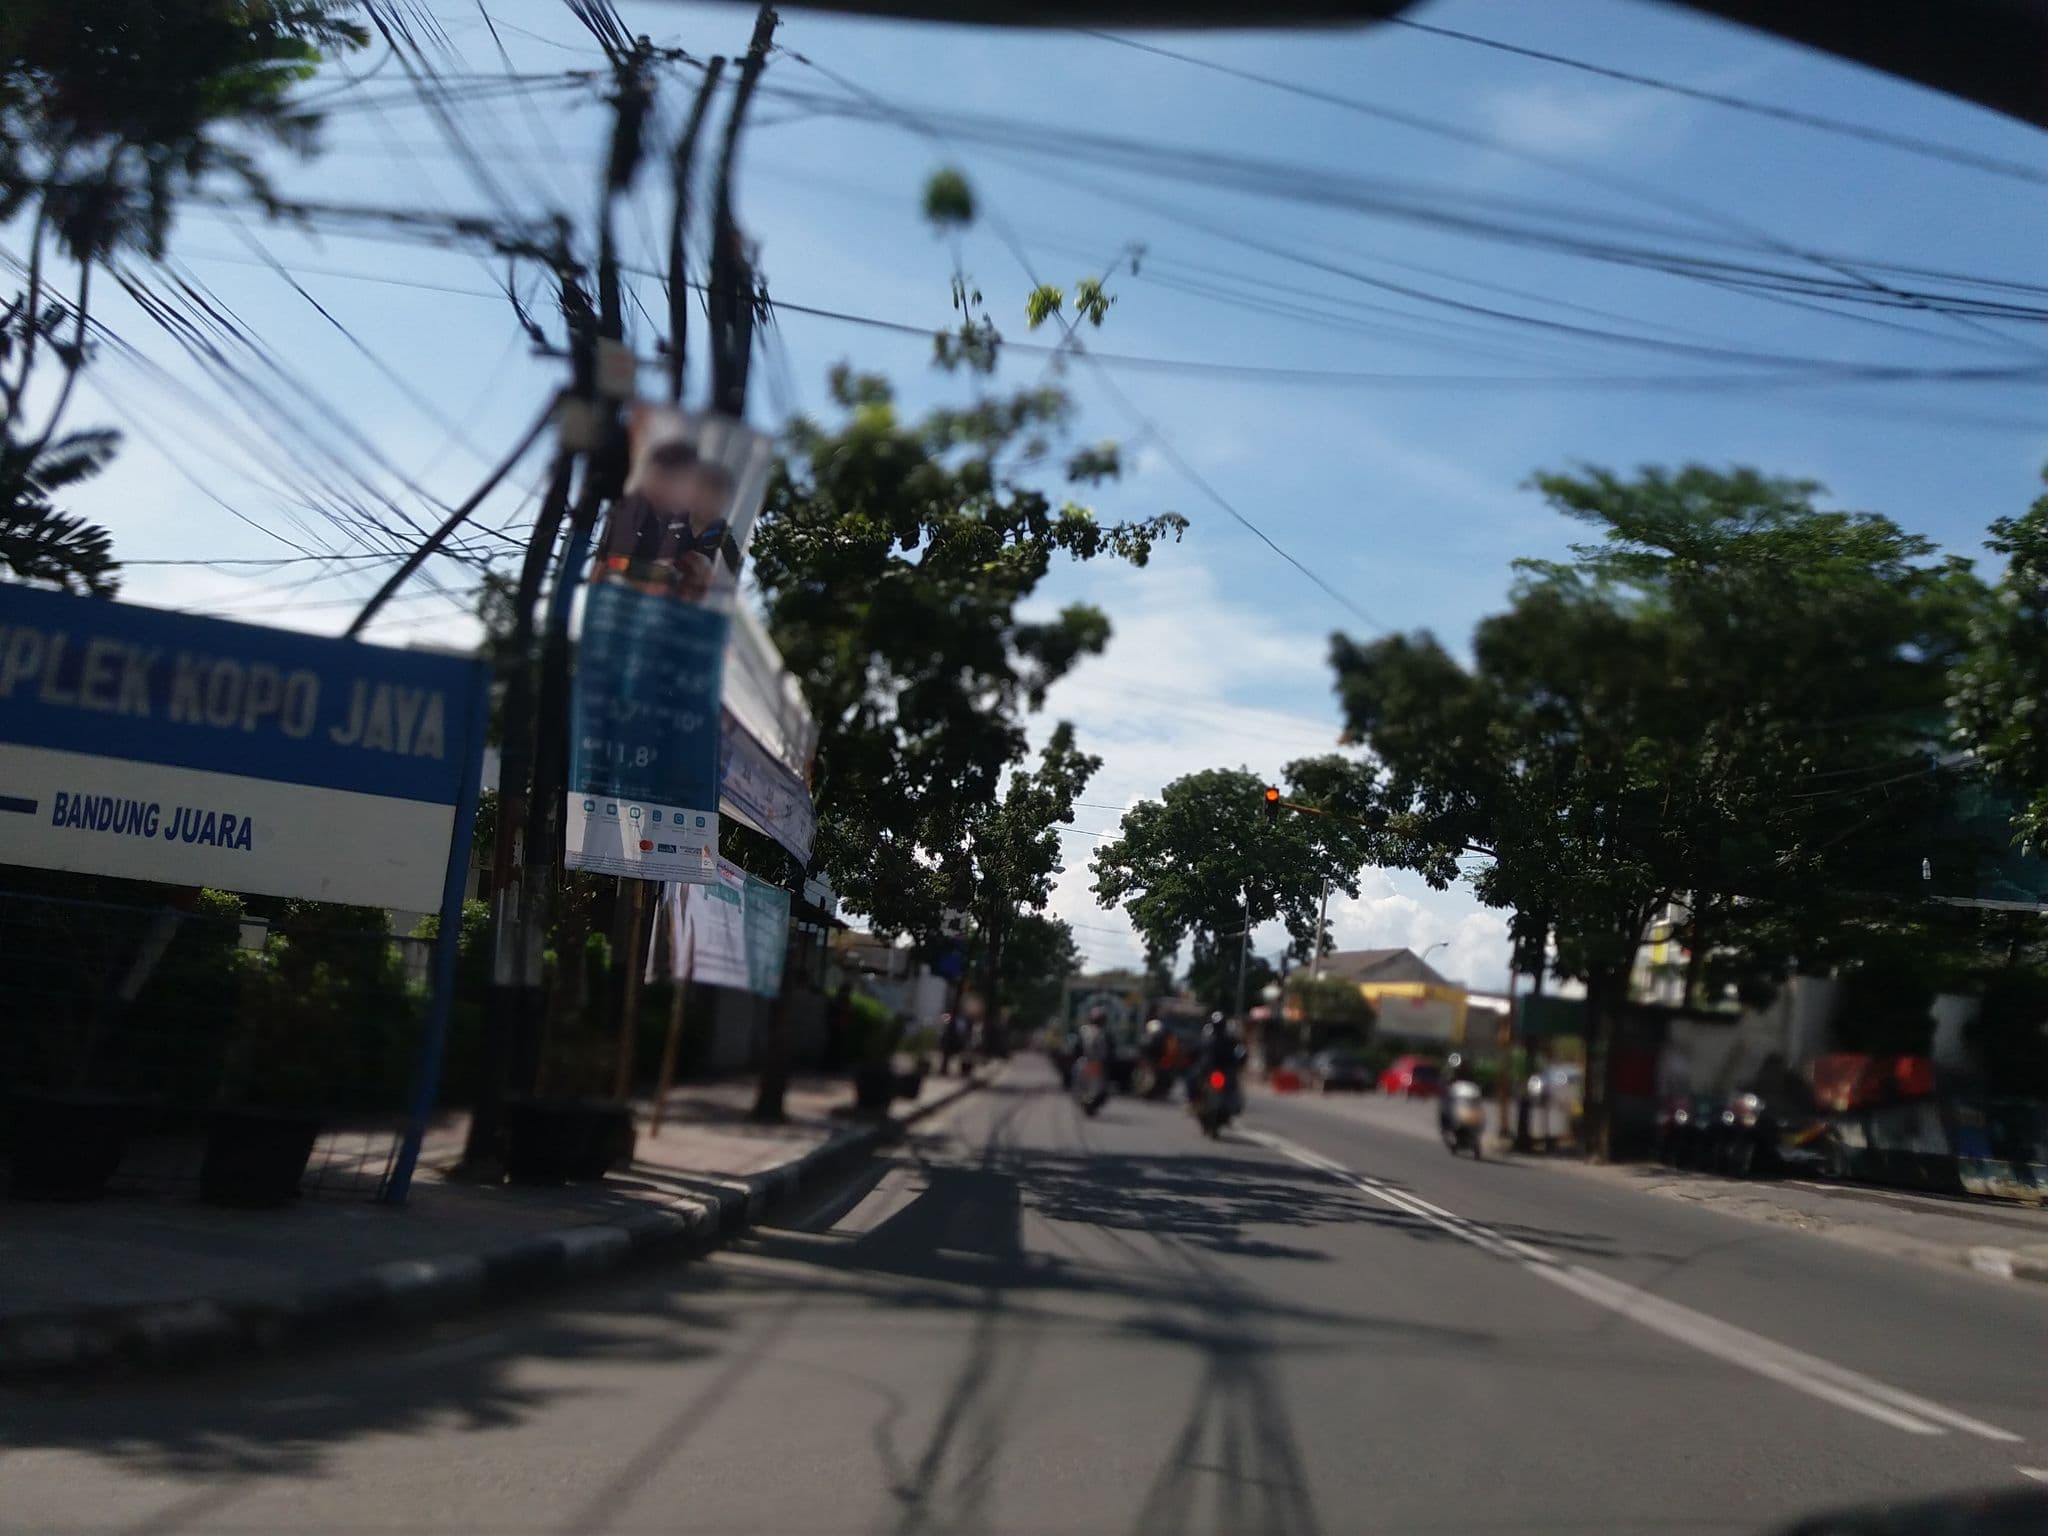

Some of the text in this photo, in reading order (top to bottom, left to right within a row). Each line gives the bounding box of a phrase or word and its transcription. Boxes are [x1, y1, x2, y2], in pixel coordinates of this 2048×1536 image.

[0, 624, 446, 760] PLEK KOPO JAYA
[51, 791, 253, 851] BANDUNG JUARA
